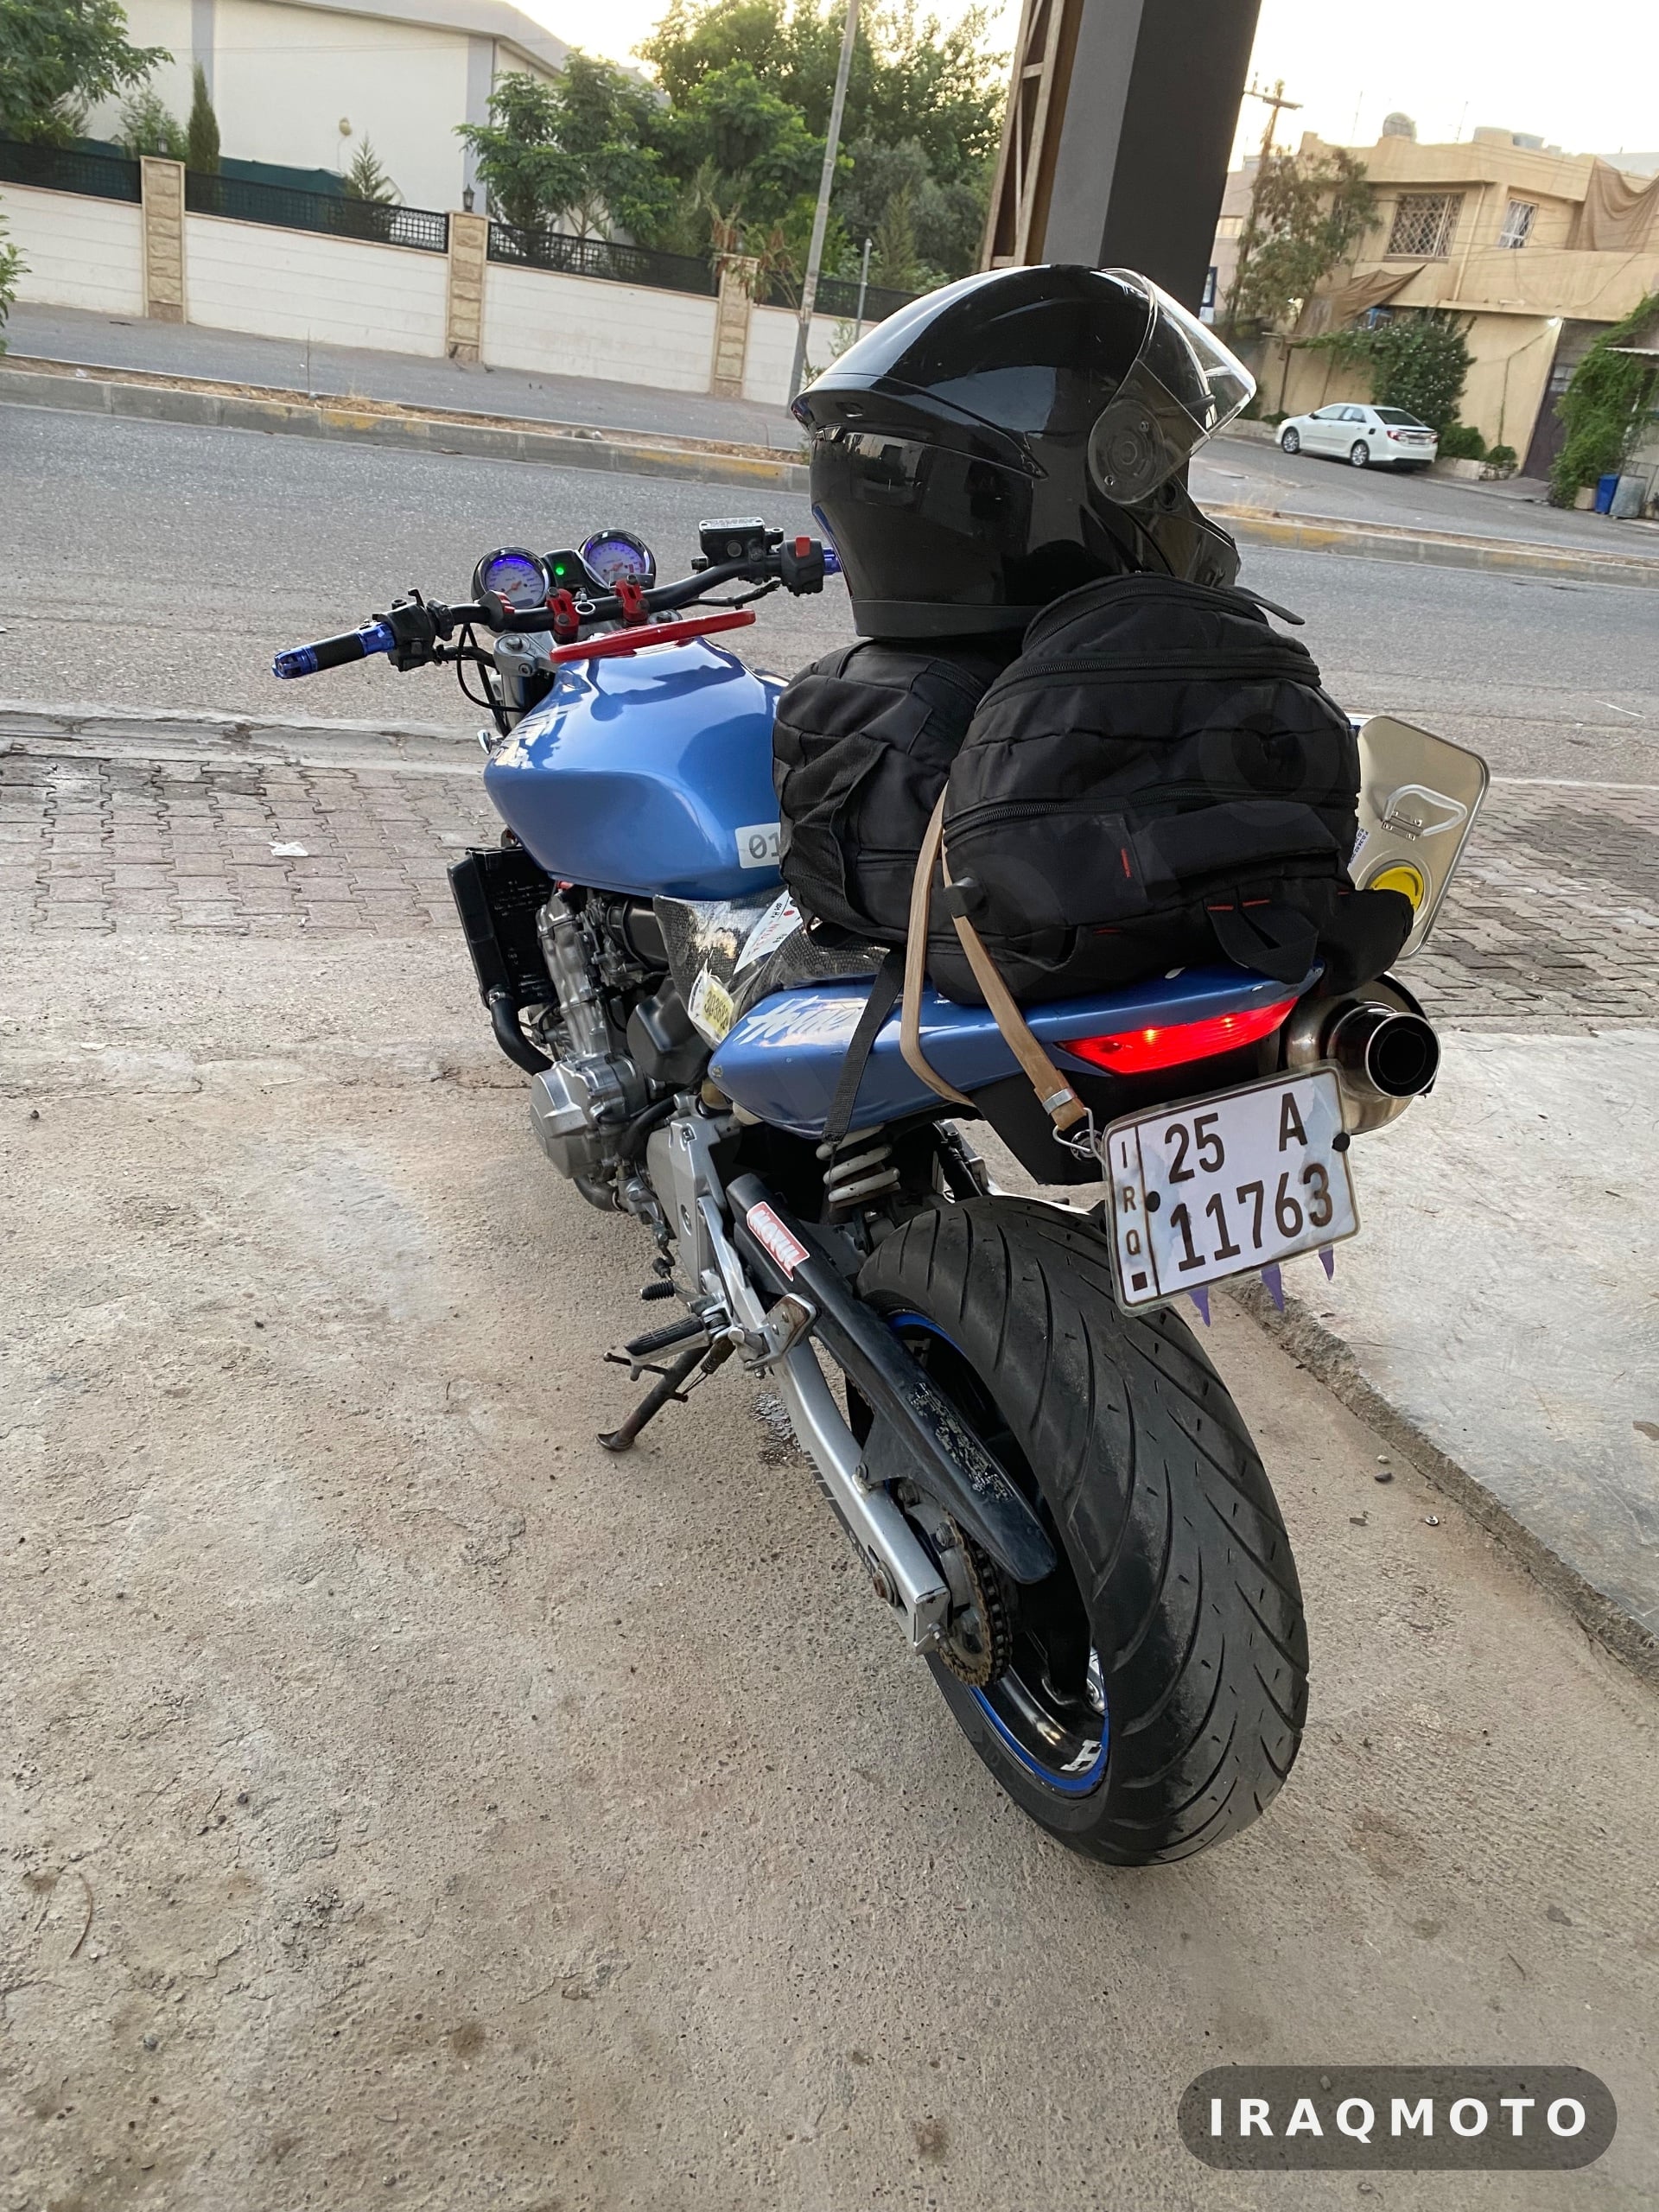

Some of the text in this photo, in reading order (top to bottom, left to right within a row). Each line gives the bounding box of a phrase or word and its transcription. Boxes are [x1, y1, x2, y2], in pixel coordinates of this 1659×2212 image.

[1164, 1091, 1308, 1185] 25 A
[1170, 1162, 1333, 1272] 11763
